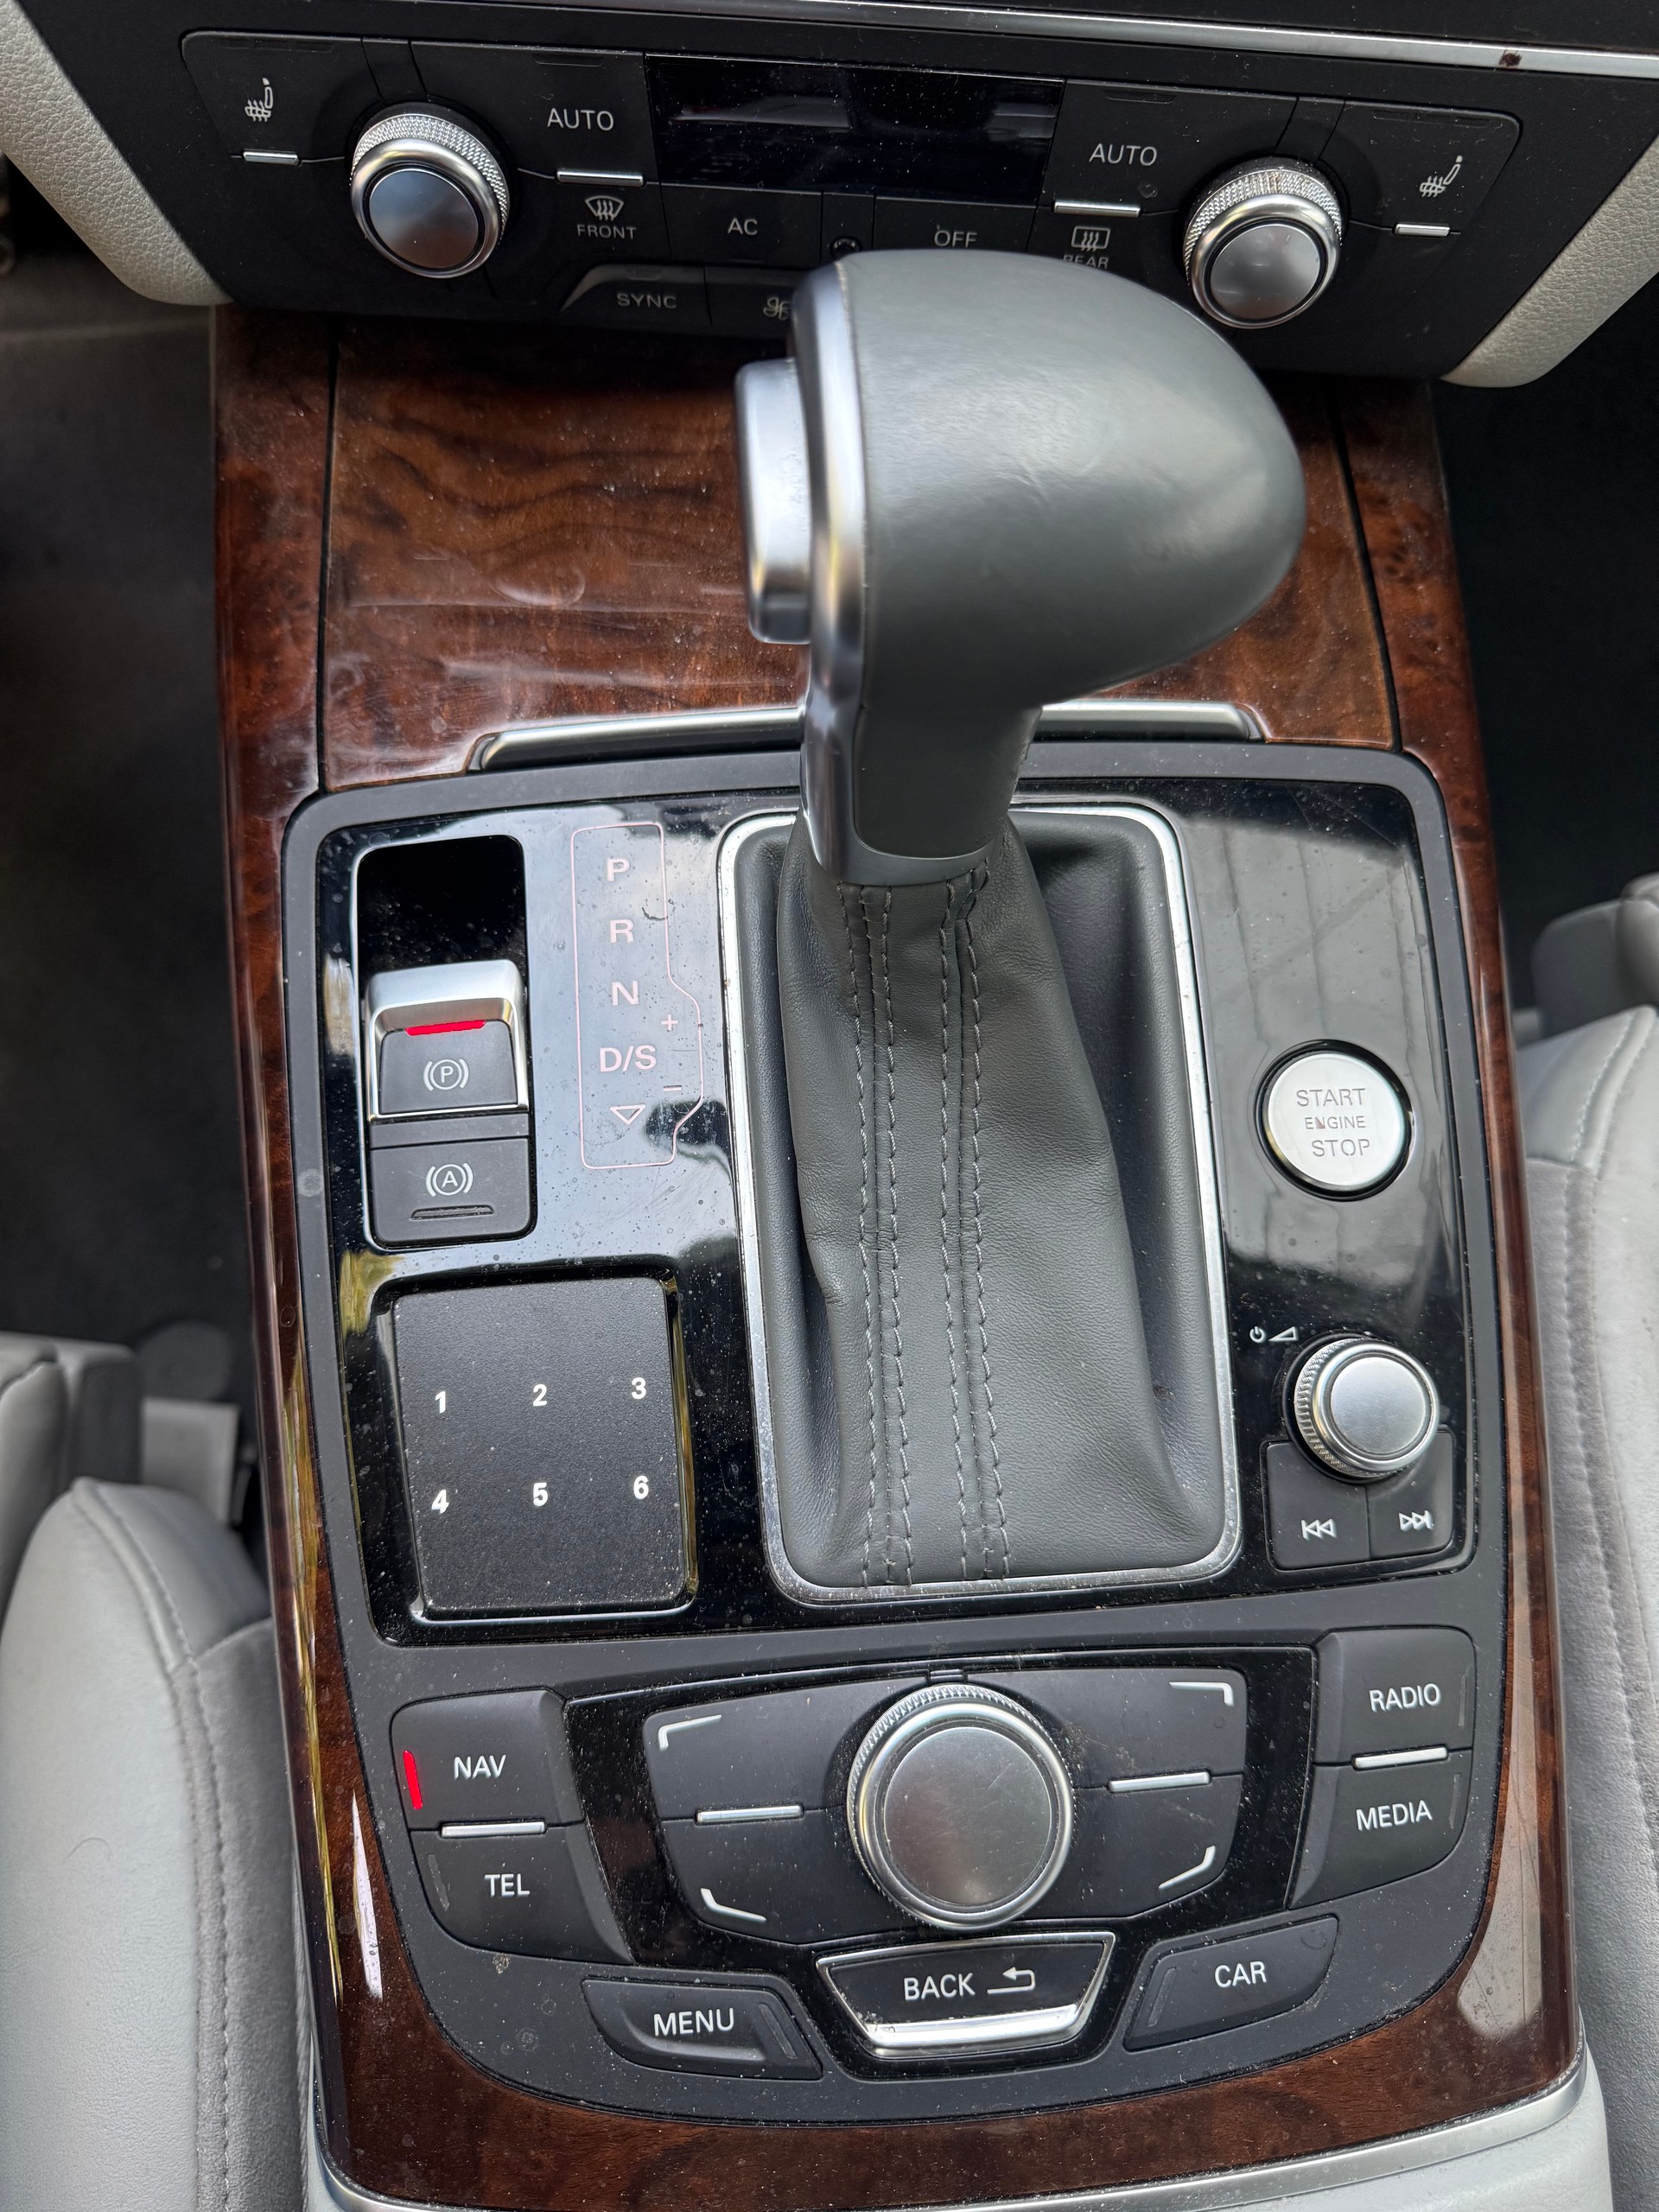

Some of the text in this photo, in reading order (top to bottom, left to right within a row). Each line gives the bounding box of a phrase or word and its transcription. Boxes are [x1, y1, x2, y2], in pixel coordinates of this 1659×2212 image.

[547, 107, 615, 132] AUTO
[1089, 143, 1159, 167] AUTO
[576, 224, 637, 240] FRONT
[728, 219, 758, 236] AC
[934, 229, 977, 248] OFF
[617, 293, 677, 310] SYNC
[607, 858, 630, 881] P
[610, 919, 633, 943] R
[612, 982, 639, 1006] N
[600, 1046, 657, 1072] D/S
[1296, 1087, 1367, 1108] START
[1305, 1116, 1366, 1130] ENGINE
[1312, 1139, 1370, 1158] STOP
[435, 1377, 647, 1414] 1 2 3
[431, 1476, 649, 1514] 4 5 6
[1369, 1682, 1442, 1713] RADIO
[454, 1754, 506, 1780] NAV
[1357, 1799, 1433, 1831] MEDIA
[484, 1873, 531, 1898] TEL
[903, 1973, 976, 2000] BACK
[1214, 1961, 1268, 1989] CAR
[653, 2007, 735, 2037] MENU
